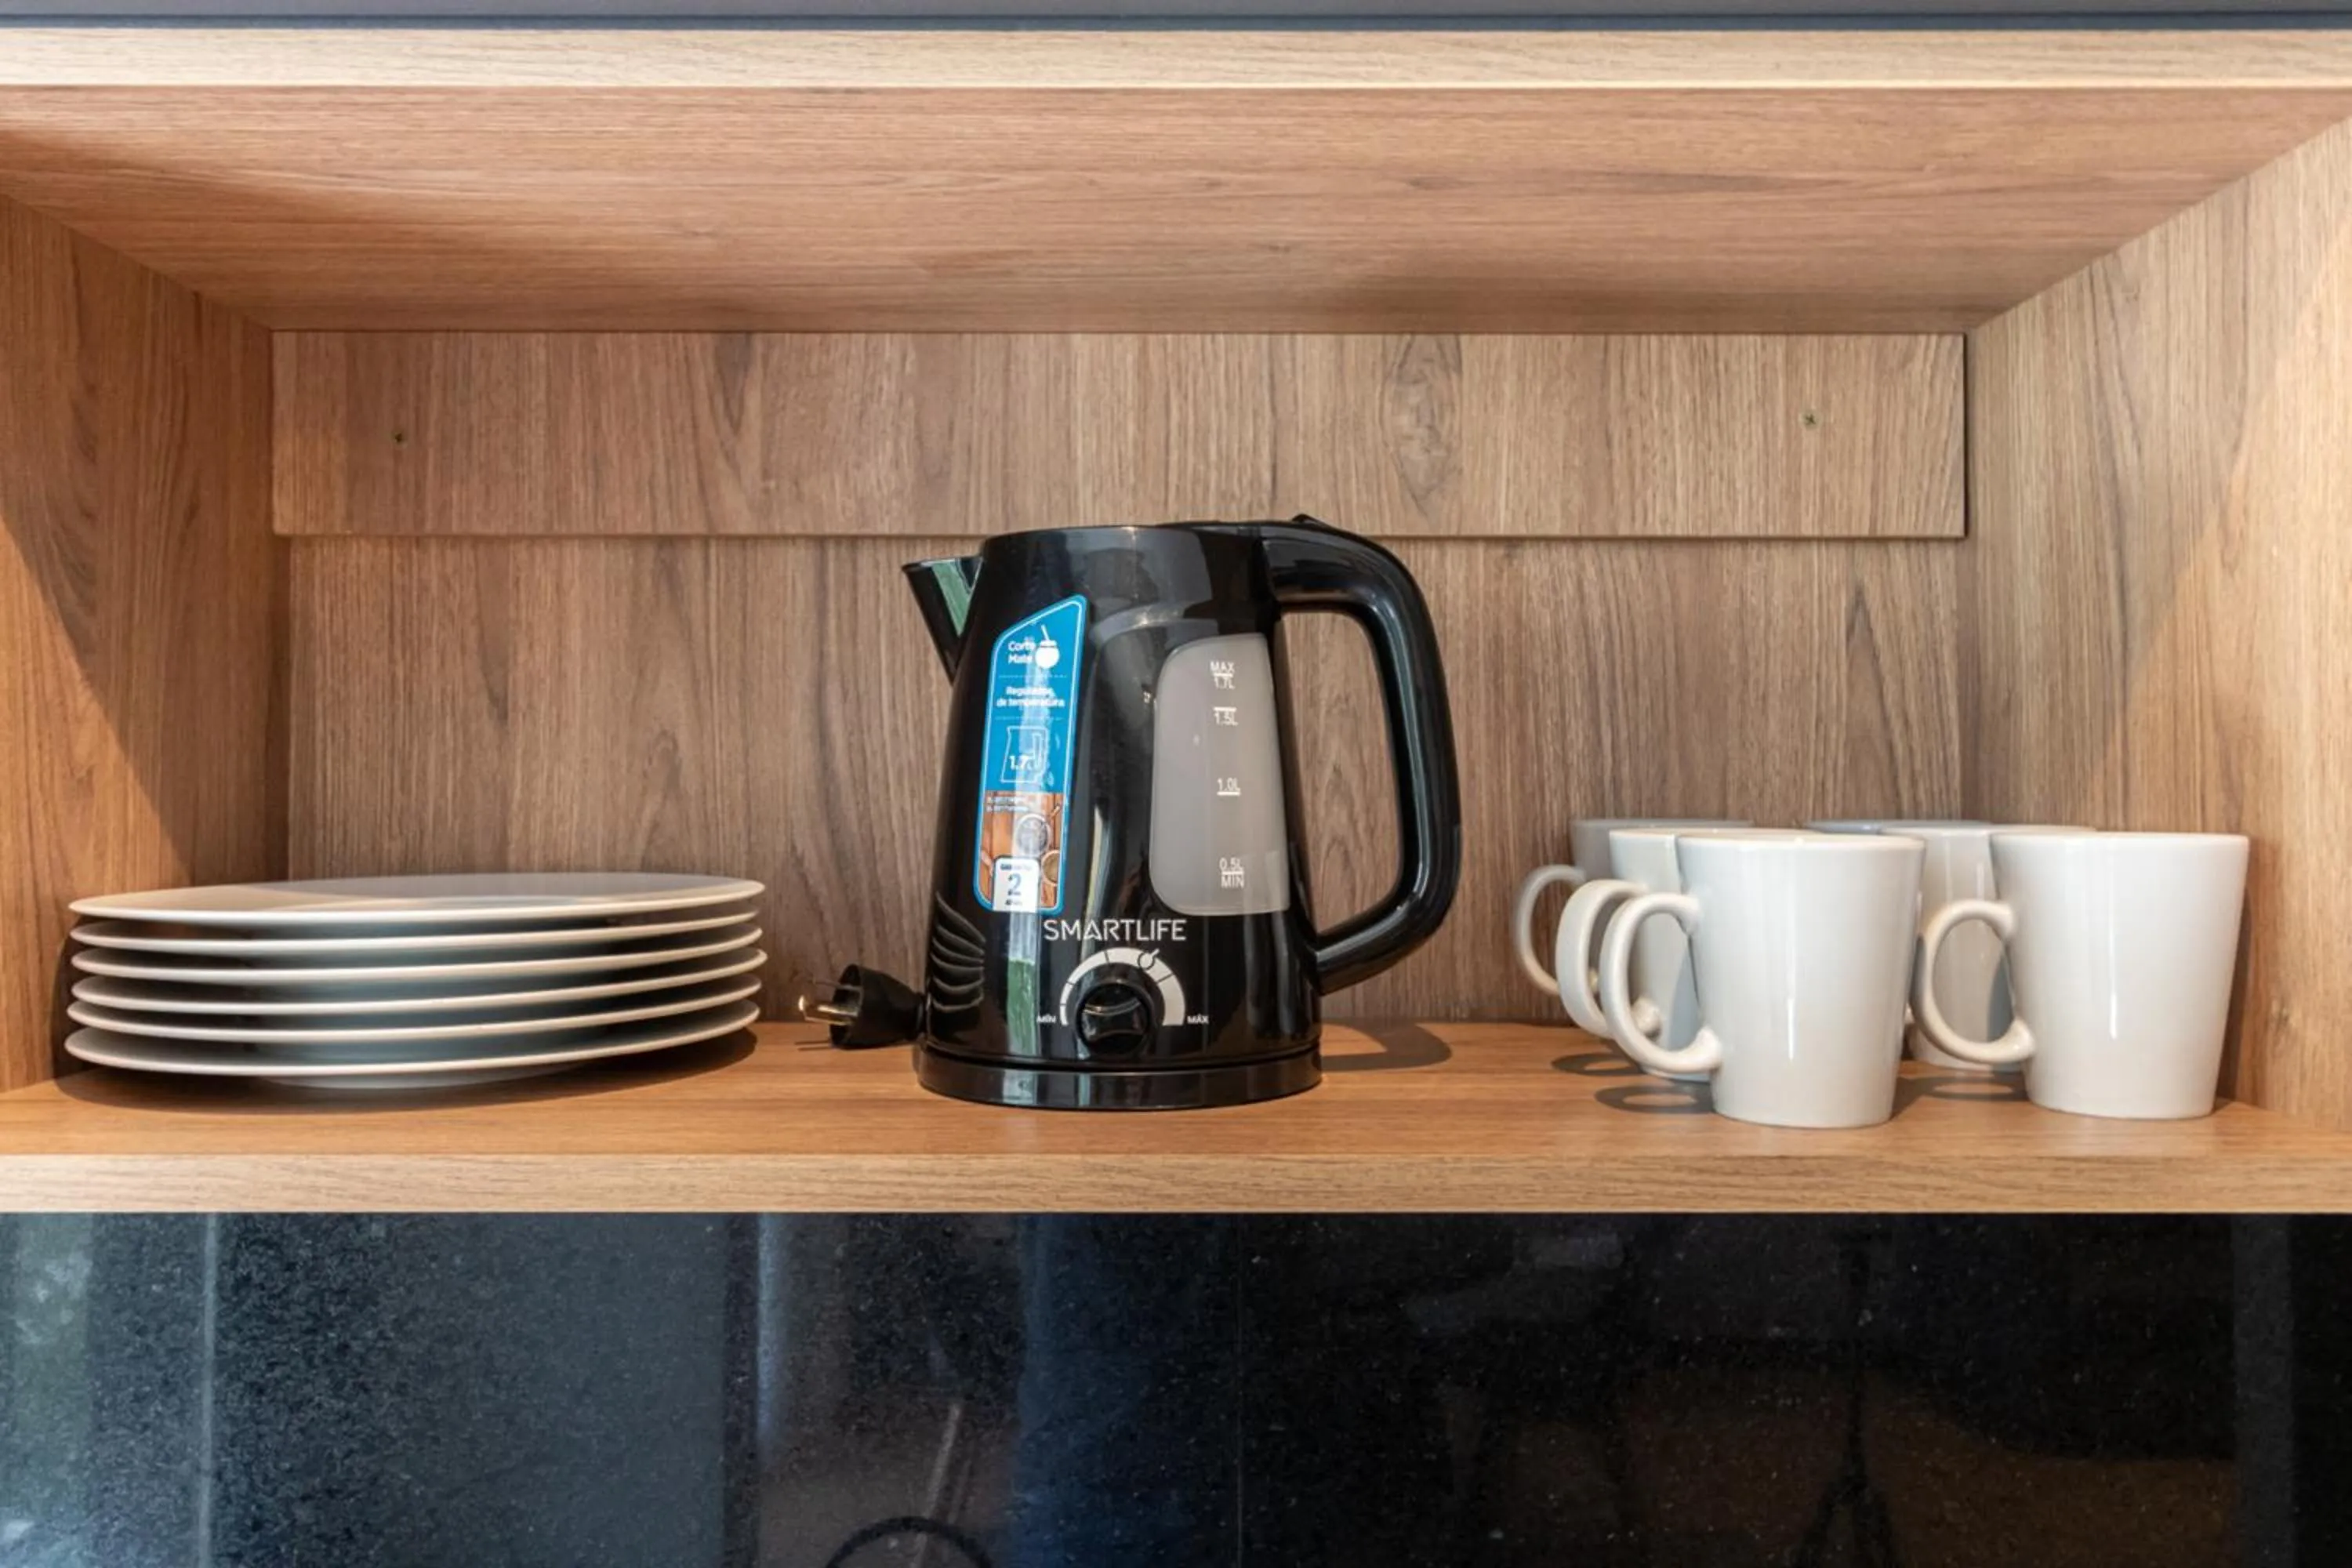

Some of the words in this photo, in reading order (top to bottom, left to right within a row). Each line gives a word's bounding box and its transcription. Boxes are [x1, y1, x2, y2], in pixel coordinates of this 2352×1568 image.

[1210, 662, 1235, 673] MAX
[1215, 710, 1238, 726] 1.5L
[1218, 779, 1240, 792] 1.0L
[1220, 858, 1243, 871] 0.5L
[1007, 873, 1022, 895] 2
[1221, 875, 1245, 888] MIN
[1044, 919, 1187, 941] SMARTLIFE
